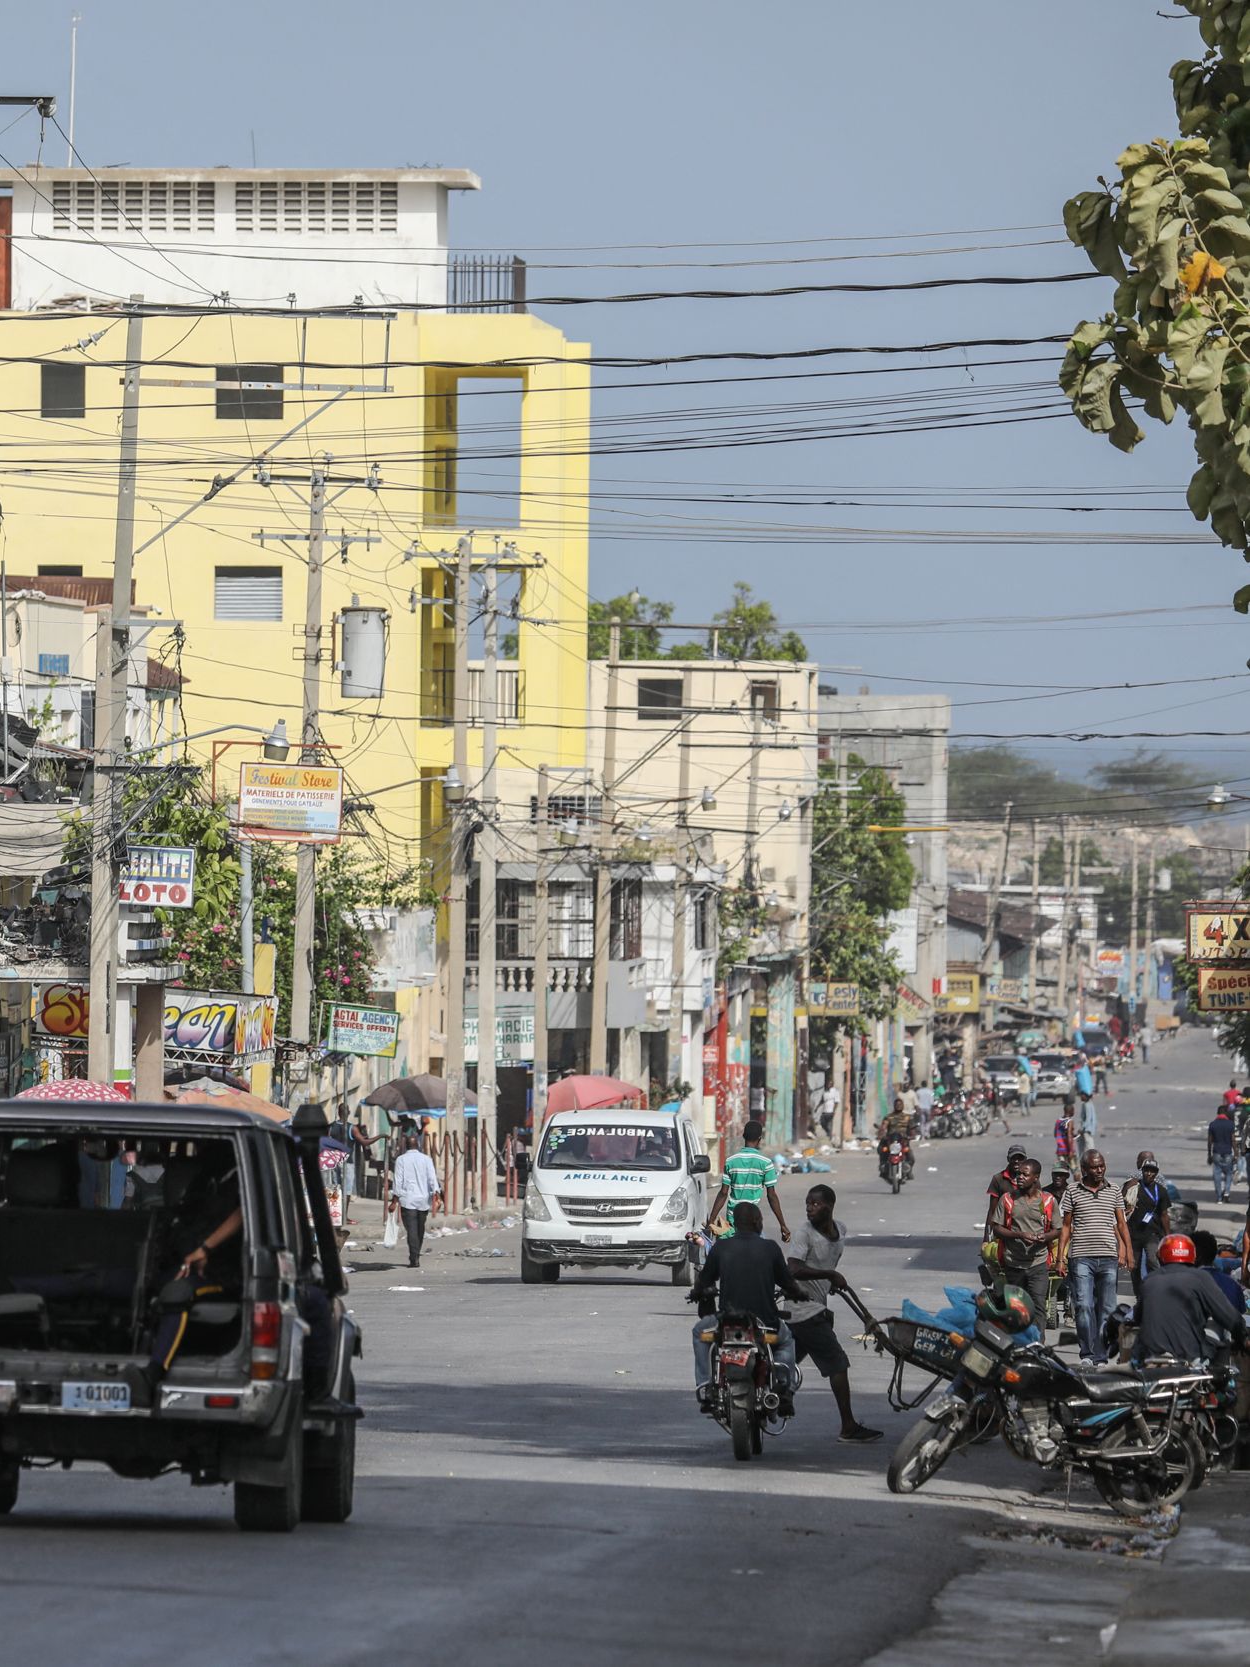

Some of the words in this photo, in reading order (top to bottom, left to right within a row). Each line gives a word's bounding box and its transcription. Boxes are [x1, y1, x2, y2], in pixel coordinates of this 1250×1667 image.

[250, 769, 298, 786] Festival
[302, 771, 332, 787] Store
[246, 788, 284, 798] MATERIELS
[296, 791, 335, 800] PATISSERIE
[118, 882, 187, 904] LOTO
[362, 1012, 396, 1025] AGENCY
[333, 1020, 364, 1030] SERVICES
[366, 1024, 395, 1033] OFFERTS
[563, 1173, 648, 1184] AMBULANCE
